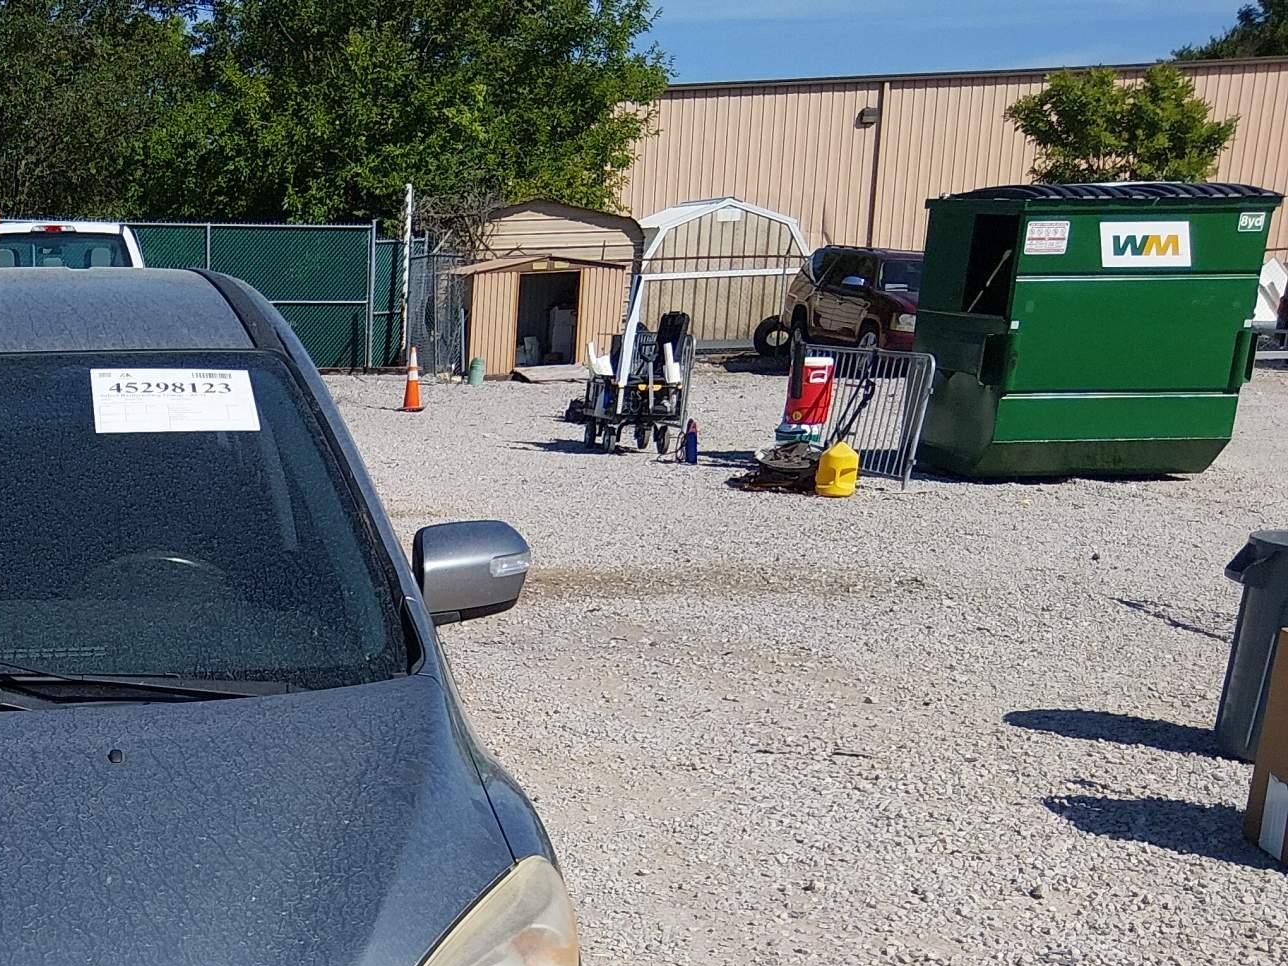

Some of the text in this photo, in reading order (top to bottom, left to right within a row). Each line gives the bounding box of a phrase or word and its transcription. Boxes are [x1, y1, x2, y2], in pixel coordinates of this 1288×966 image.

[1240, 215, 1264, 229] 8yd
[1112, 234, 1180, 256] WM
[108, 382, 232, 394] 45298123
